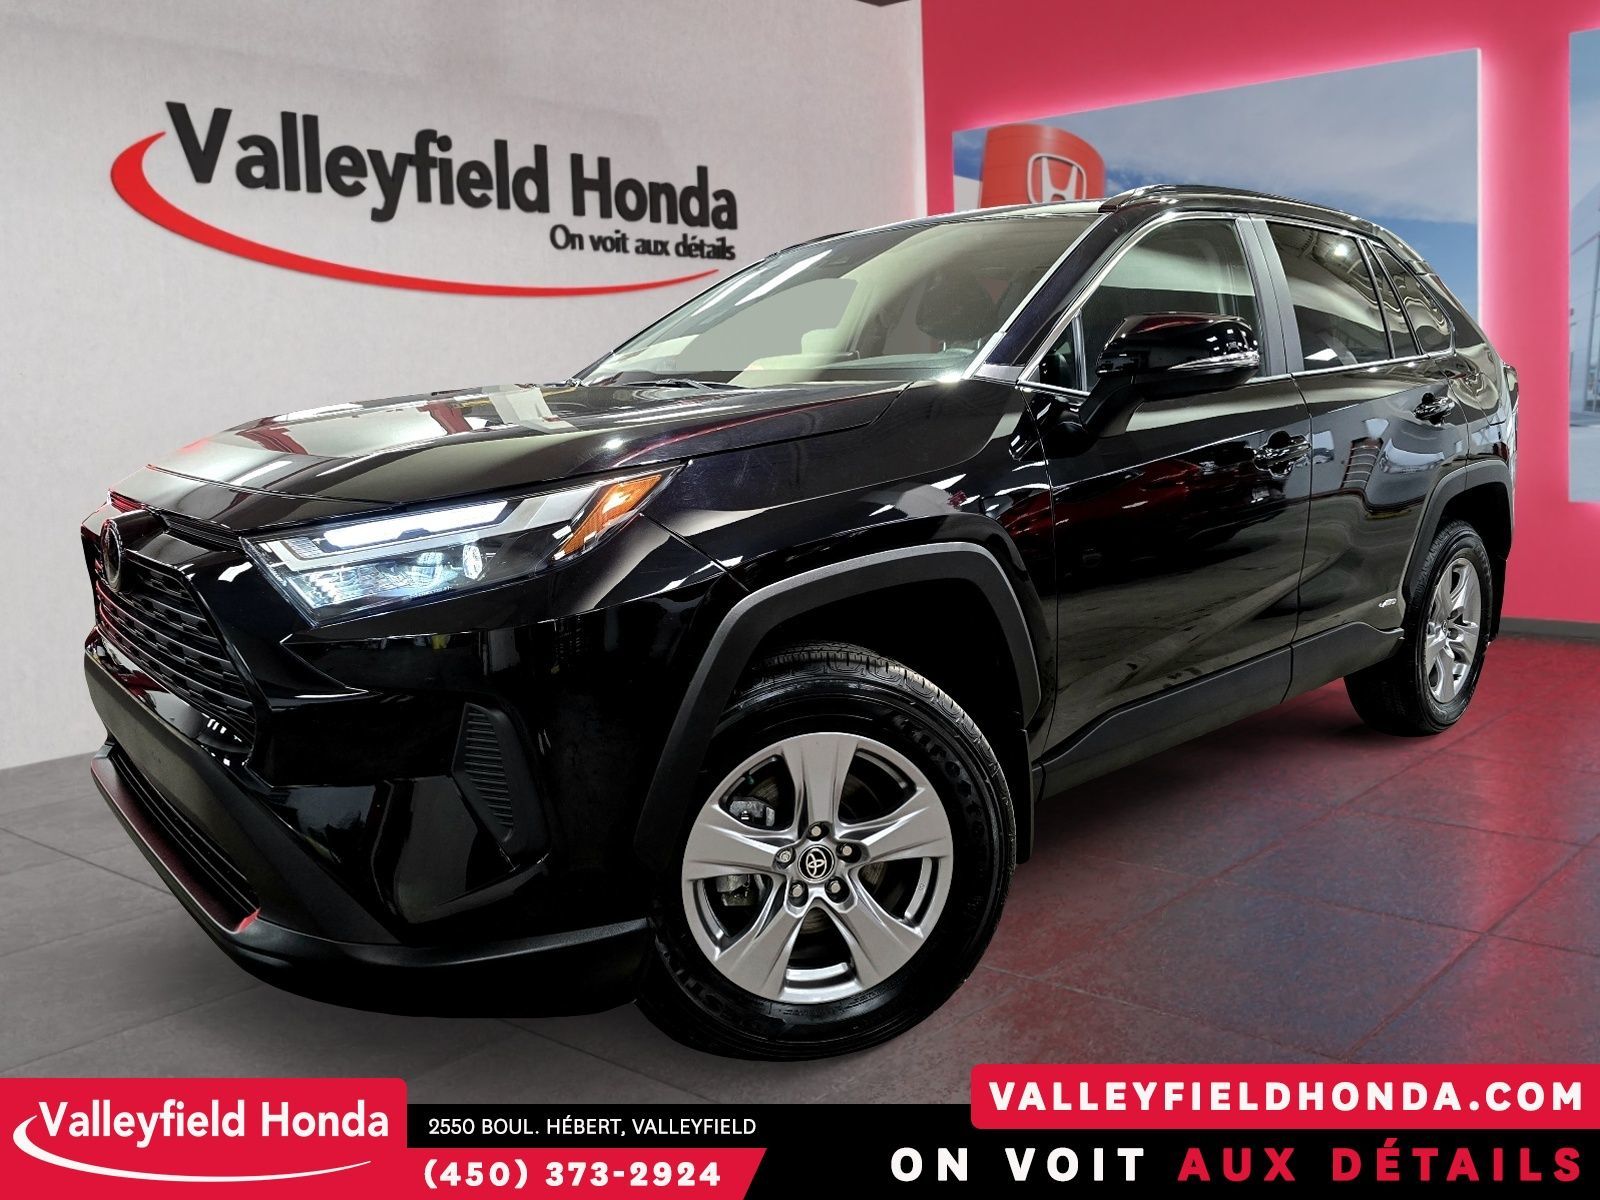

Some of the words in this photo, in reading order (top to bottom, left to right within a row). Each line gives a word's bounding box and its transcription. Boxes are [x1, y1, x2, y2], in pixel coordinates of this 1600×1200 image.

[165, 101, 550, 223] Valleyfield
[570, 153, 738, 231] Honda
[550, 224, 585, 251] On
[588, 230, 629, 254] voit
[634, 238, 671, 257] aux
[674, 232, 736, 261] détails
